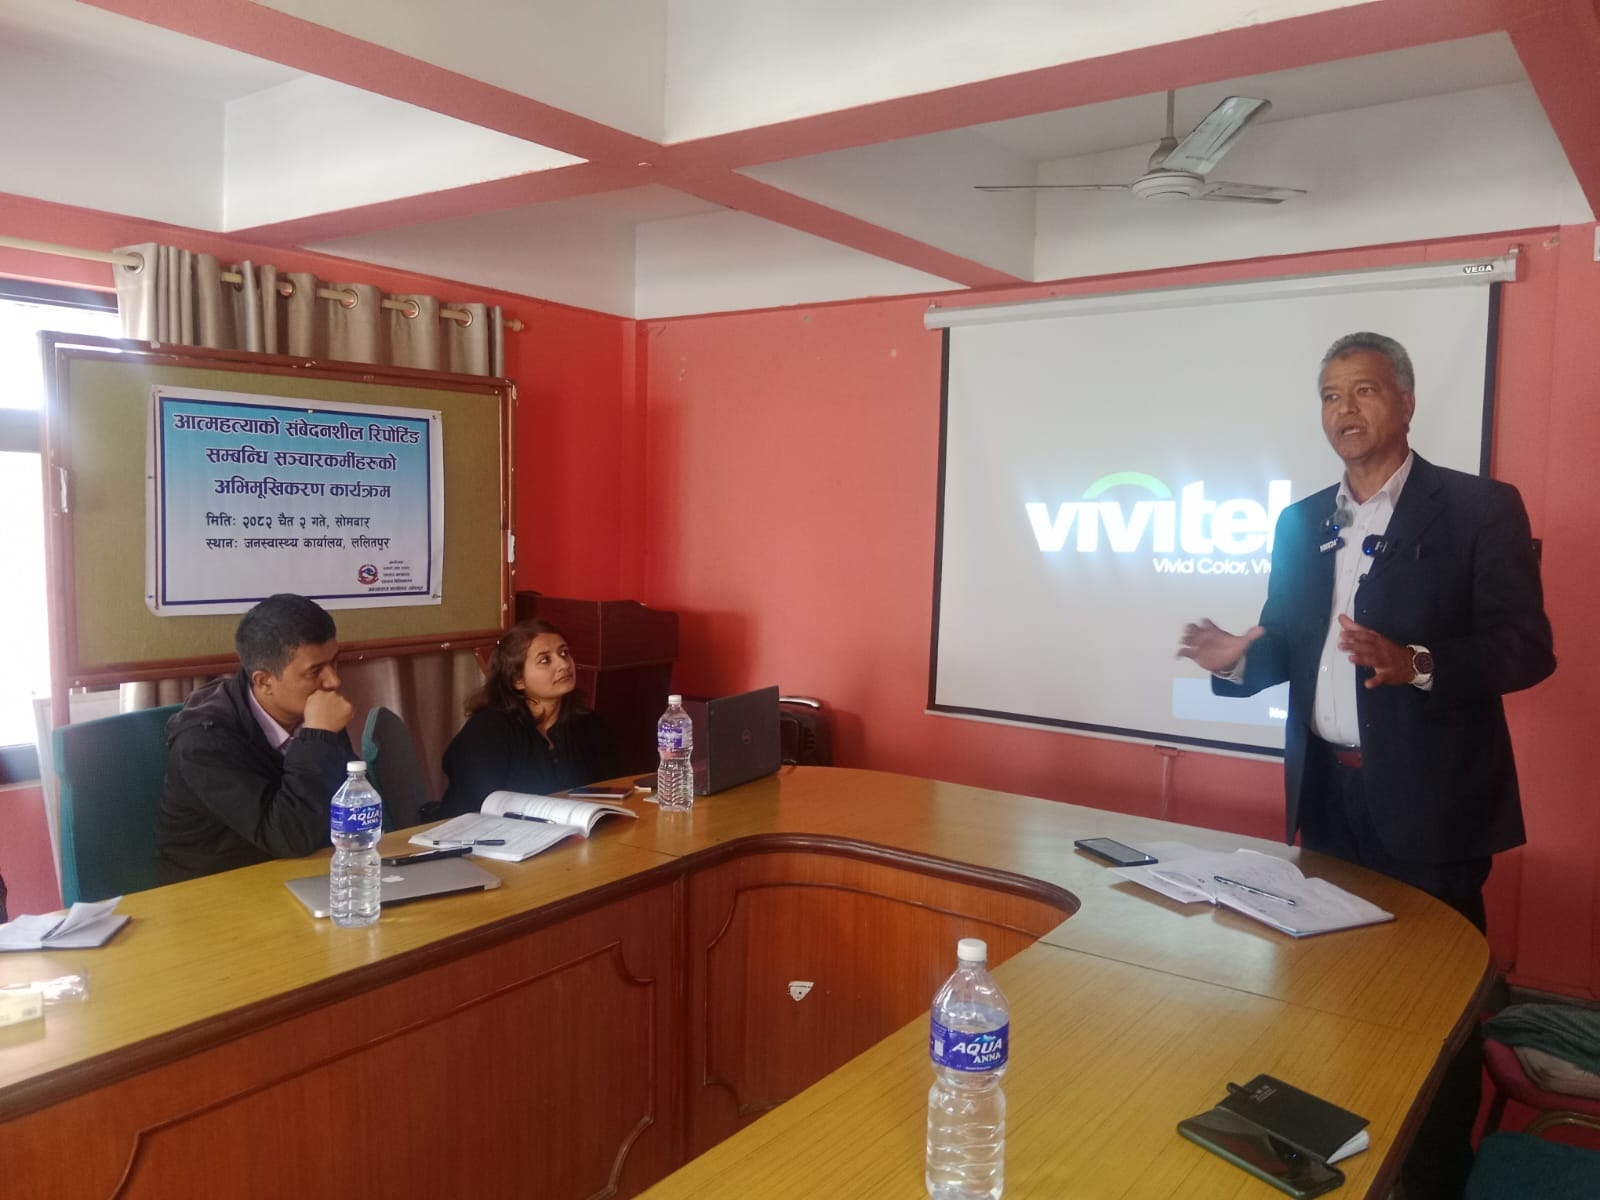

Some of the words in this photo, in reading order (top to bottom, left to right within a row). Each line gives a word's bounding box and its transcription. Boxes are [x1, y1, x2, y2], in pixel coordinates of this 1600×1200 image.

[174, 414, 280, 435] आत्महत्याको
[369, 423, 420, 444] रिपोर्टिङ
[206, 445, 268, 464] सम्बन्धि
[214, 475, 325, 499] अभिमूखिकरण
[330, 481, 392, 498] कार्यक्रम
[243, 516, 273, 528] २०८२
[277, 512, 295, 527] चैत
[299, 516, 306, 528] २
[311, 514, 329, 529] गते,
[244, 538, 299, 549] जनस्वास्थ्य
[303, 535, 346, 549] कार्यालय,
[351, 534, 391, 551] ललितपुर
[1153, 558, 1194, 574] Vivid
[1197, 557, 1249, 576] Color,
[347, 810, 379, 821] AQUA
[952, 1038, 1002, 1056] AQUA
[973, 1052, 1001, 1063] ANNA
